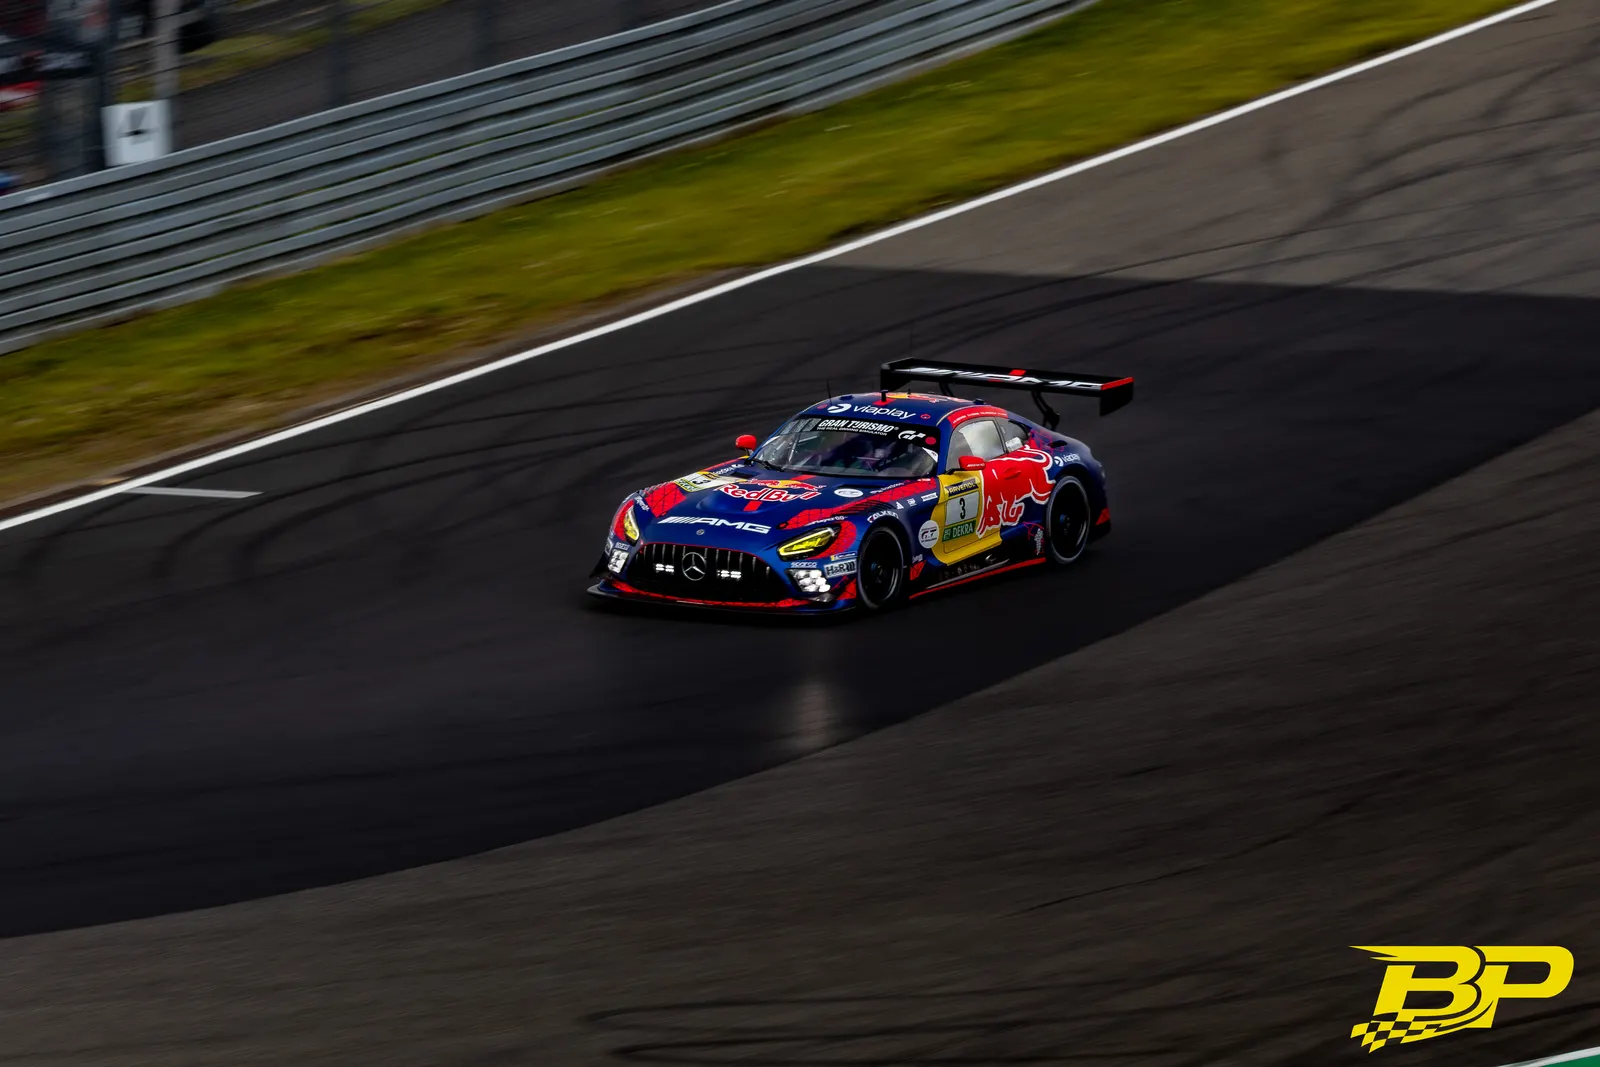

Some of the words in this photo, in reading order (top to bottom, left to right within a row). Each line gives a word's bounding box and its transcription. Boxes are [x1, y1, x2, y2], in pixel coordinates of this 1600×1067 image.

[853, 404, 917, 419] viaplay
[817, 418, 847, 428] GRAN
[713, 483, 766, 501] Red
[949, 481, 977, 494] RAVENOL
[959, 498, 966, 519] 3
[867, 510, 899, 523] FALKEN
[690, 517, 772, 534] AMG
[952, 523, 974, 538] DEKRA
